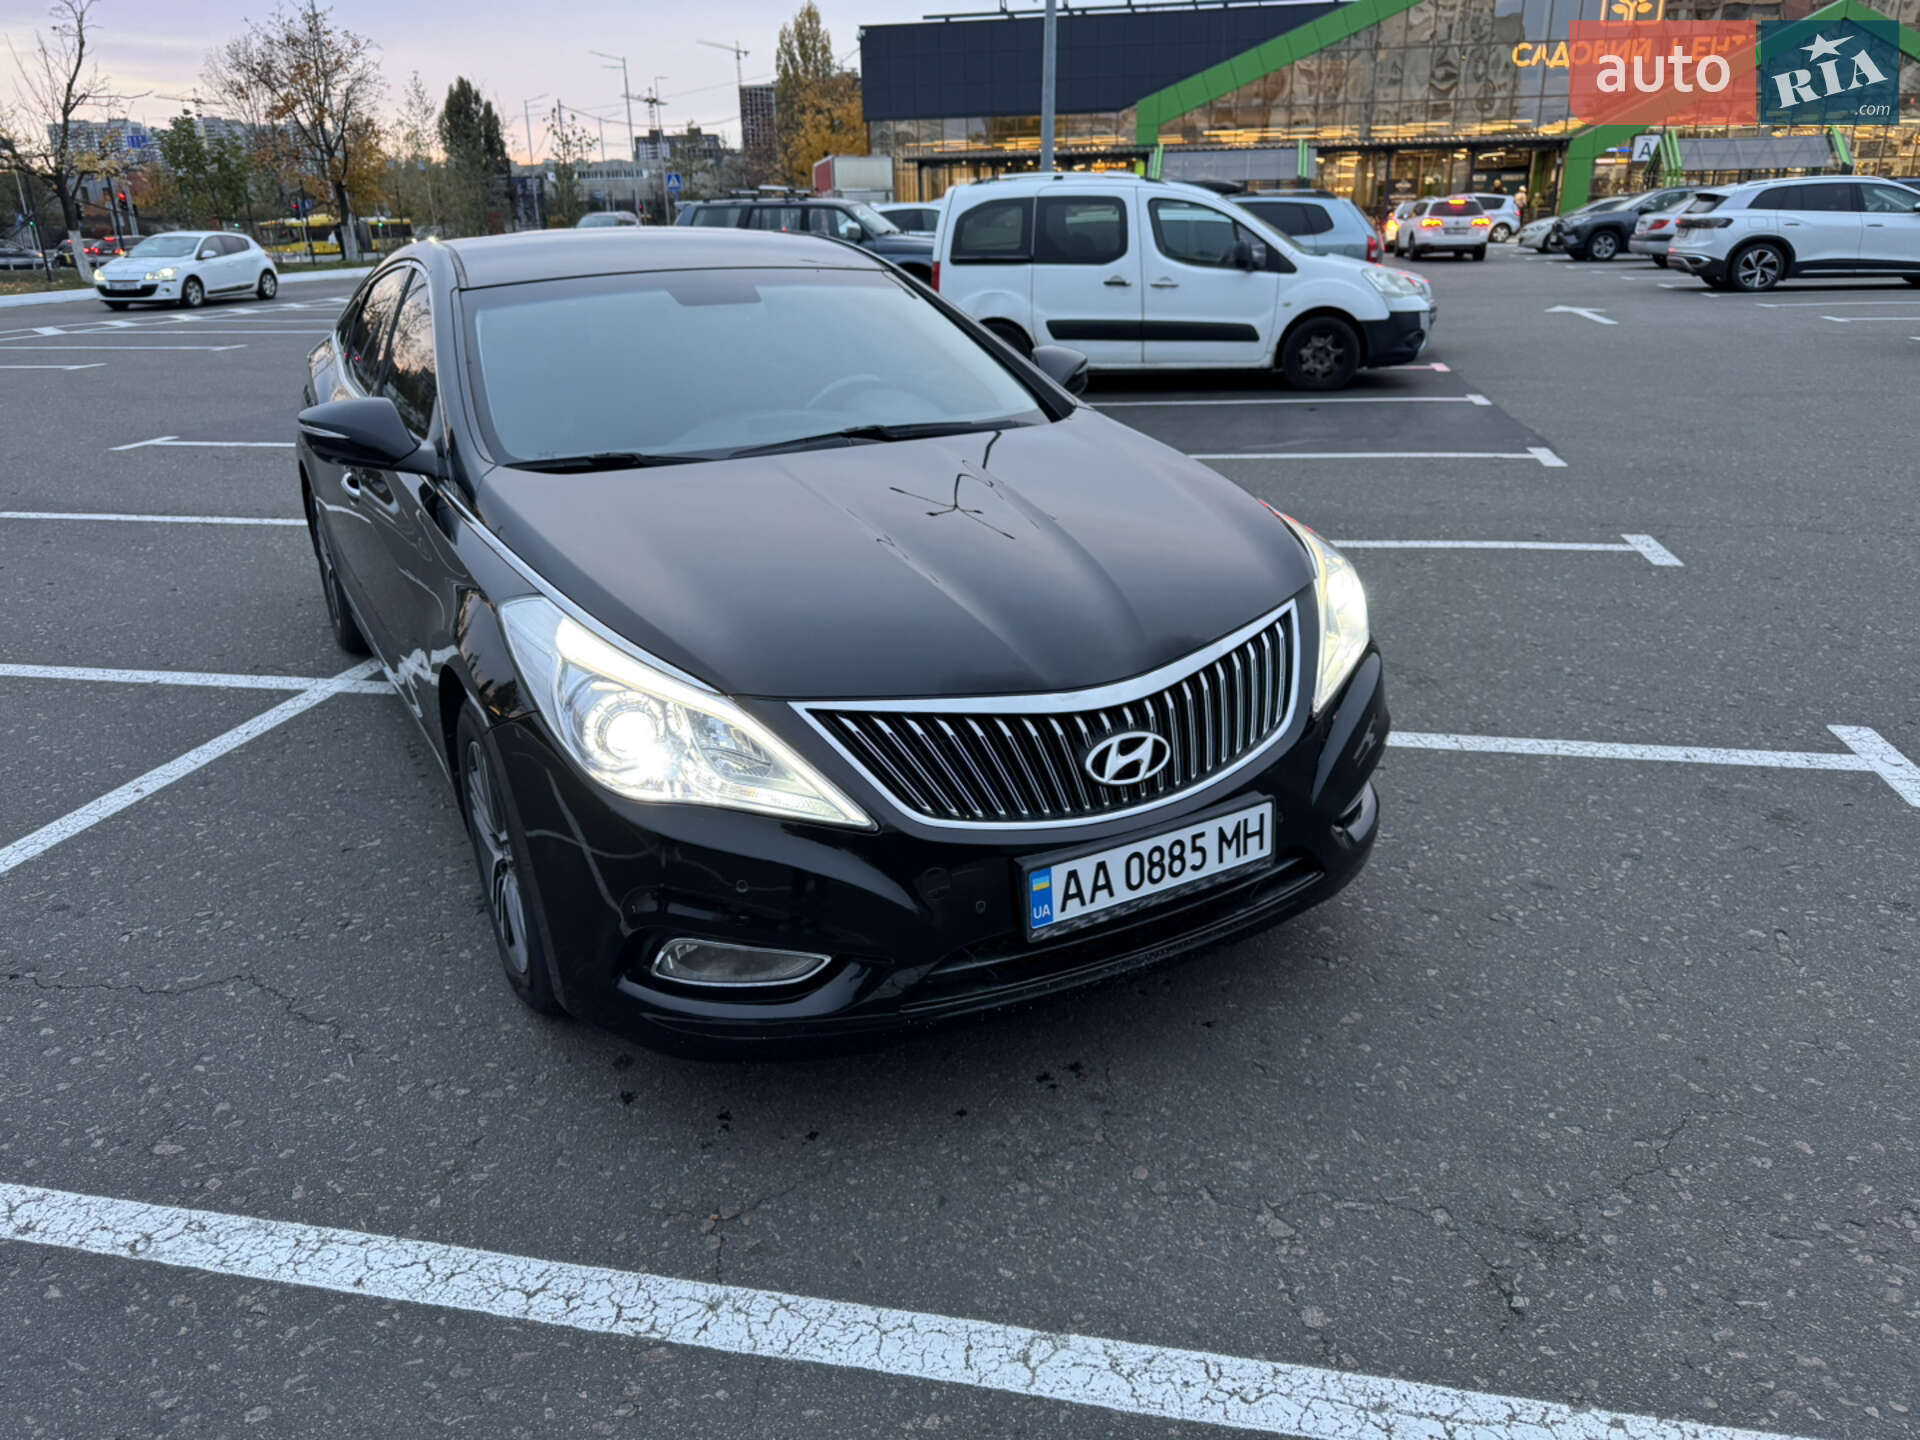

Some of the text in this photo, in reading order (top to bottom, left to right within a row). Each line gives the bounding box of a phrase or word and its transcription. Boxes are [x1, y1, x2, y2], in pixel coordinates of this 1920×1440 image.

[1060, 812, 1265, 913] AA 0885 MH
[1033, 904, 1051, 919] UA
